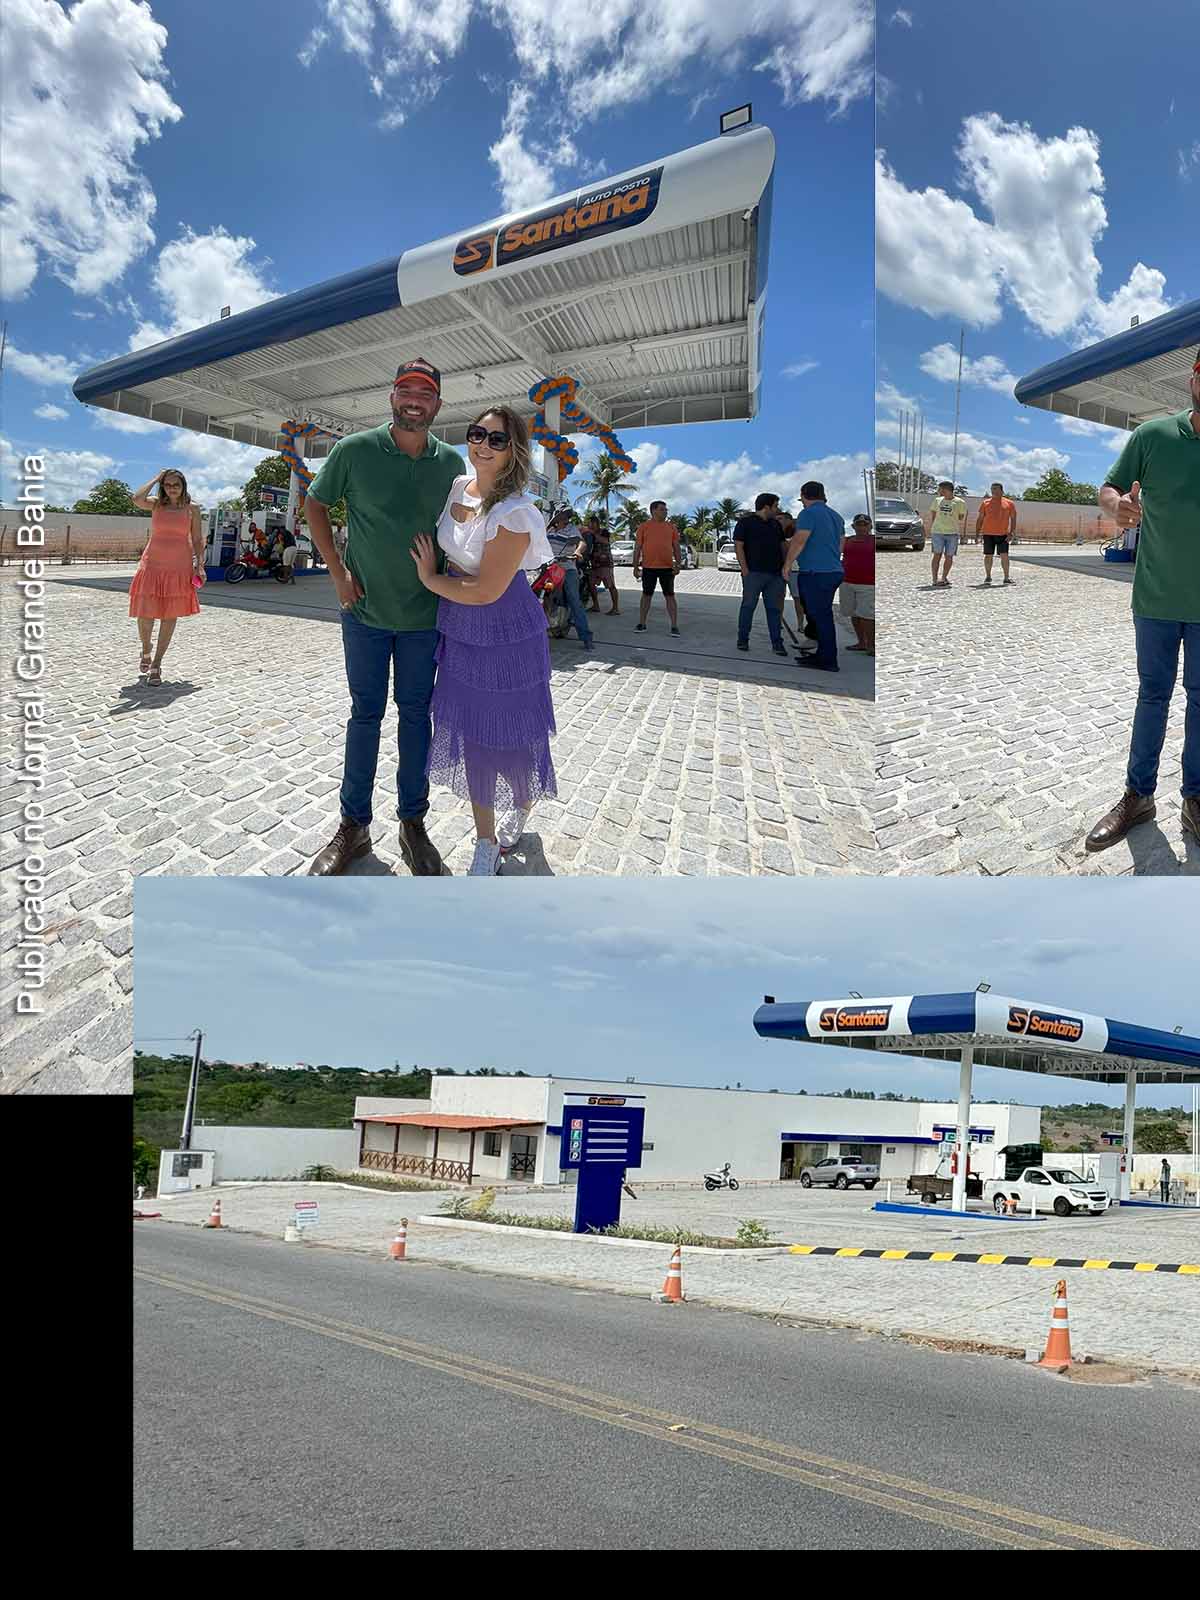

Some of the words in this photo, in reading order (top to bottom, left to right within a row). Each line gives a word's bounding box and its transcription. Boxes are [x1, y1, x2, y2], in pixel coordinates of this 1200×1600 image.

[582, 190, 612, 206] AUTO
[613, 176, 651, 195] POSTO
[502, 186, 650, 252] Santana
[838, 1011, 887, 1026] Santana
[1029, 1016, 1080, 1037] Santana
